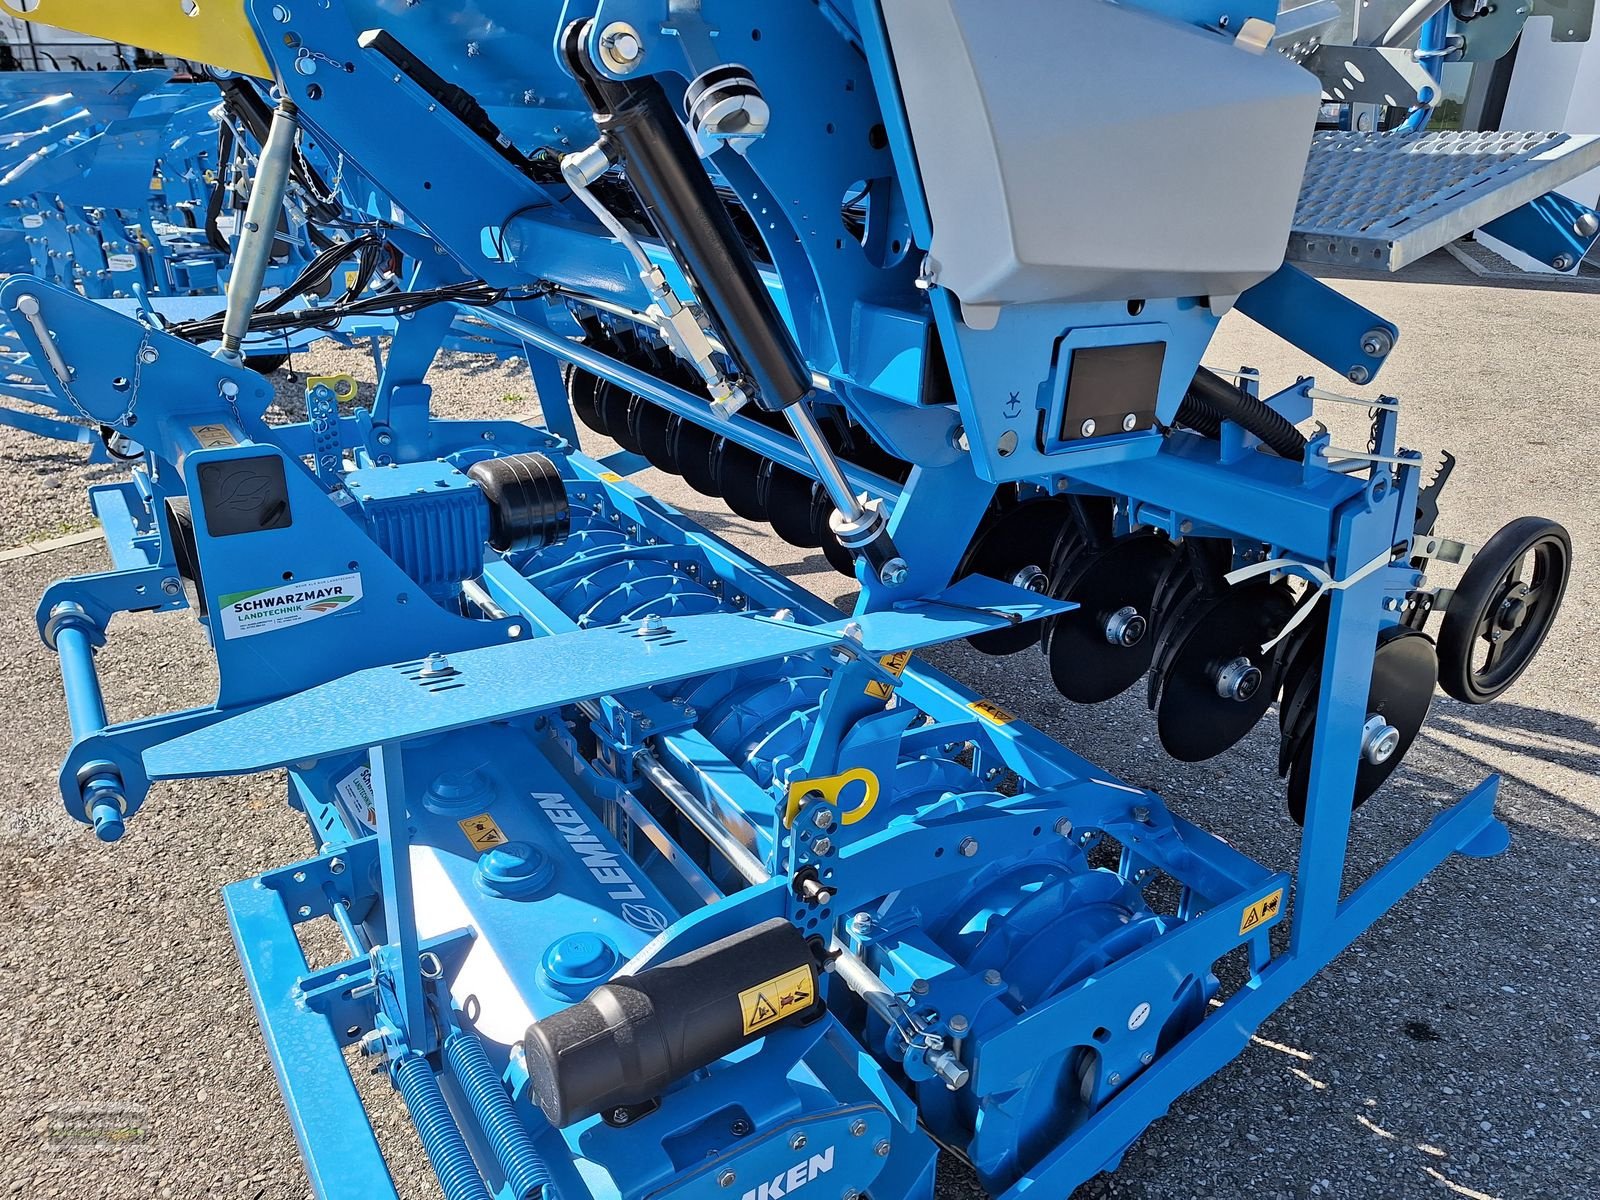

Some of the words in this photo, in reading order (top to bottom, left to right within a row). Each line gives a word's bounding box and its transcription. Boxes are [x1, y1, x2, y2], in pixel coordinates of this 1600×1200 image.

[234, 586, 343, 613] SCHWARZMAYR
[238, 604, 303, 622] LANDTECHNIK
[530, 792, 646, 900] LEMKEN
